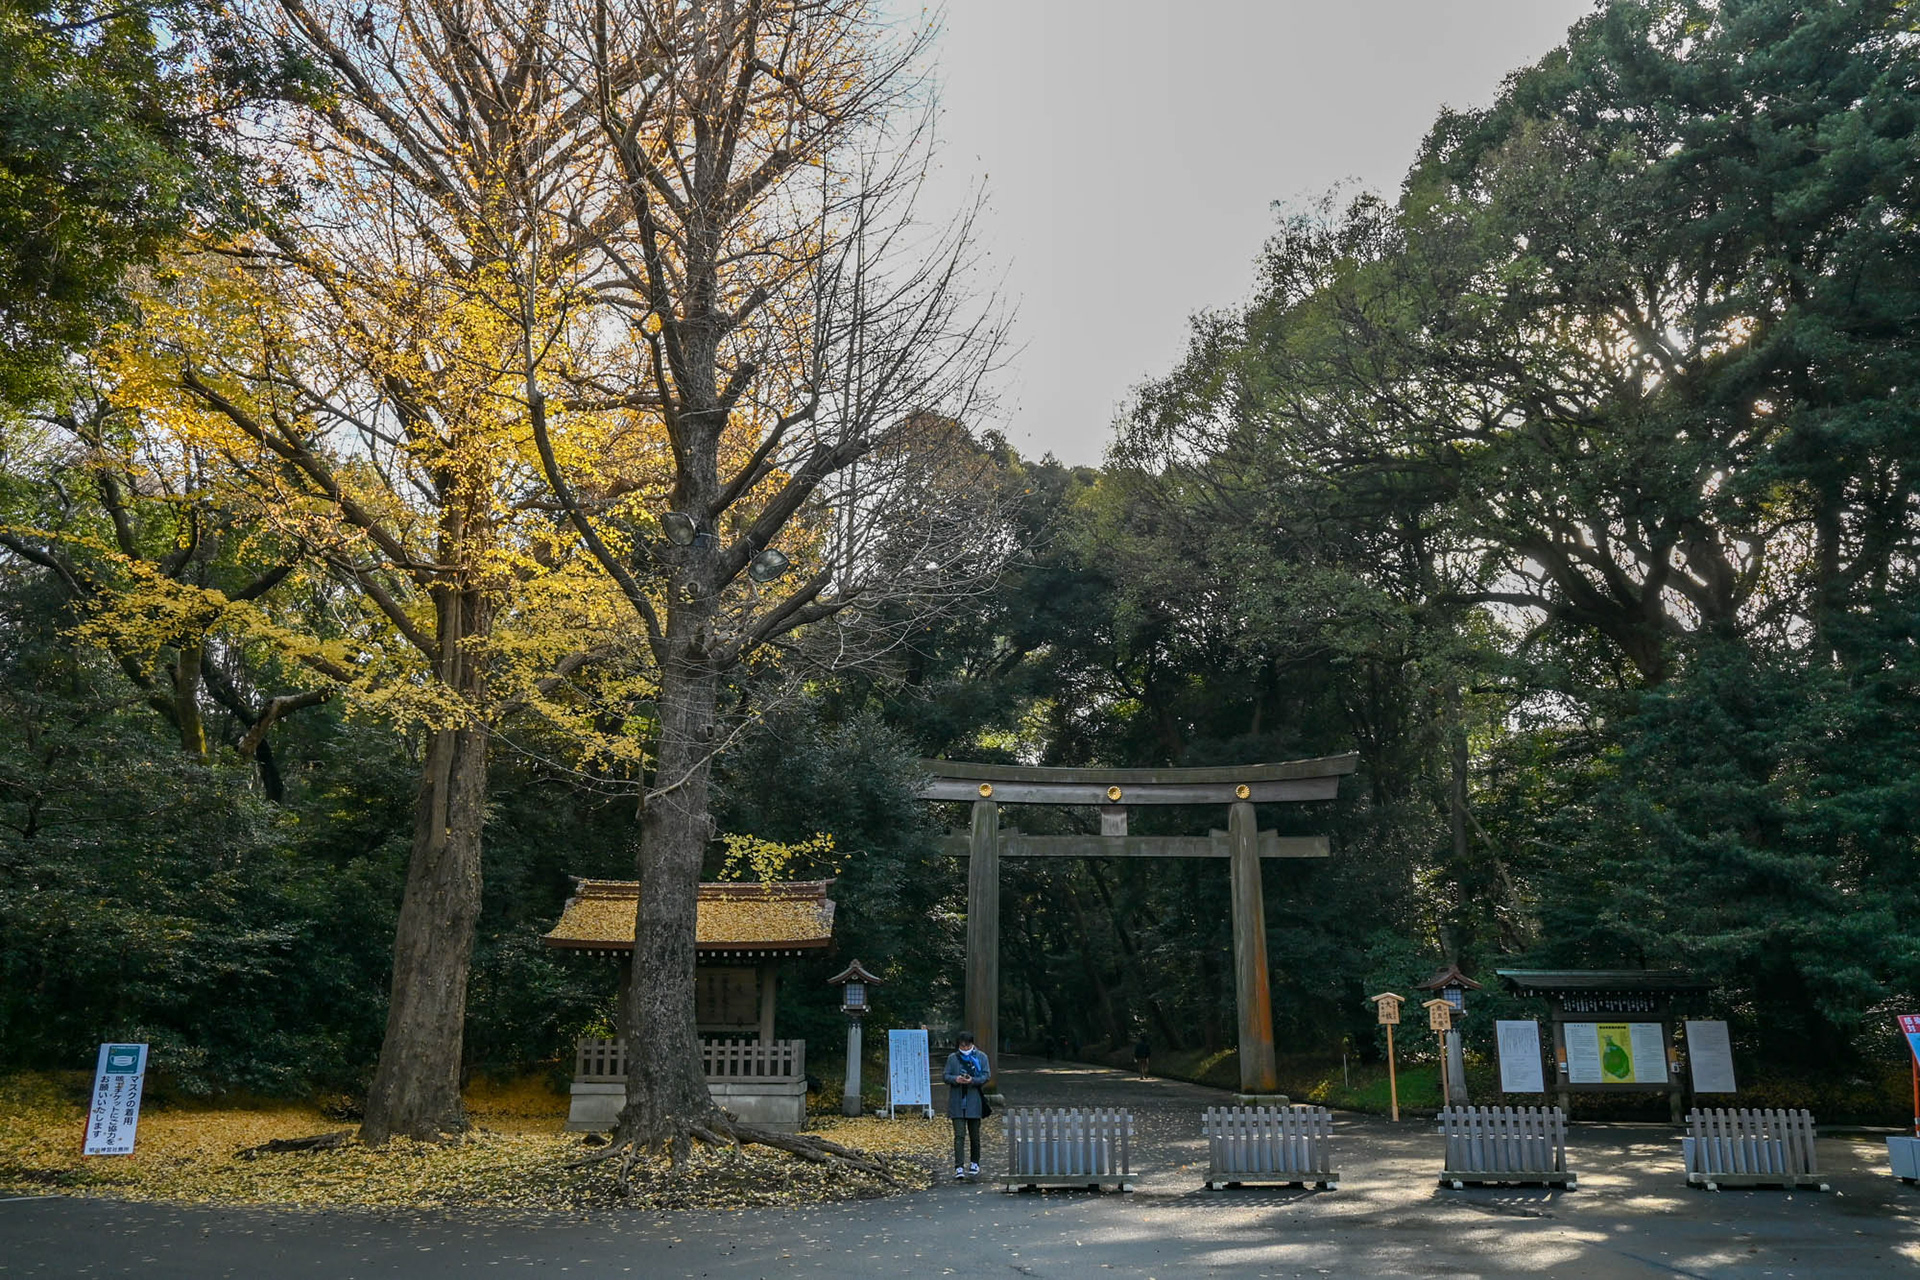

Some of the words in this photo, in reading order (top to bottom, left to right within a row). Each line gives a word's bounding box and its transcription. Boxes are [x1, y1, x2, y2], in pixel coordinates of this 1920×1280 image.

[92, 1075, 111, 1138] お願いいたします
[123, 1075, 139, 1125] マスクの着用
